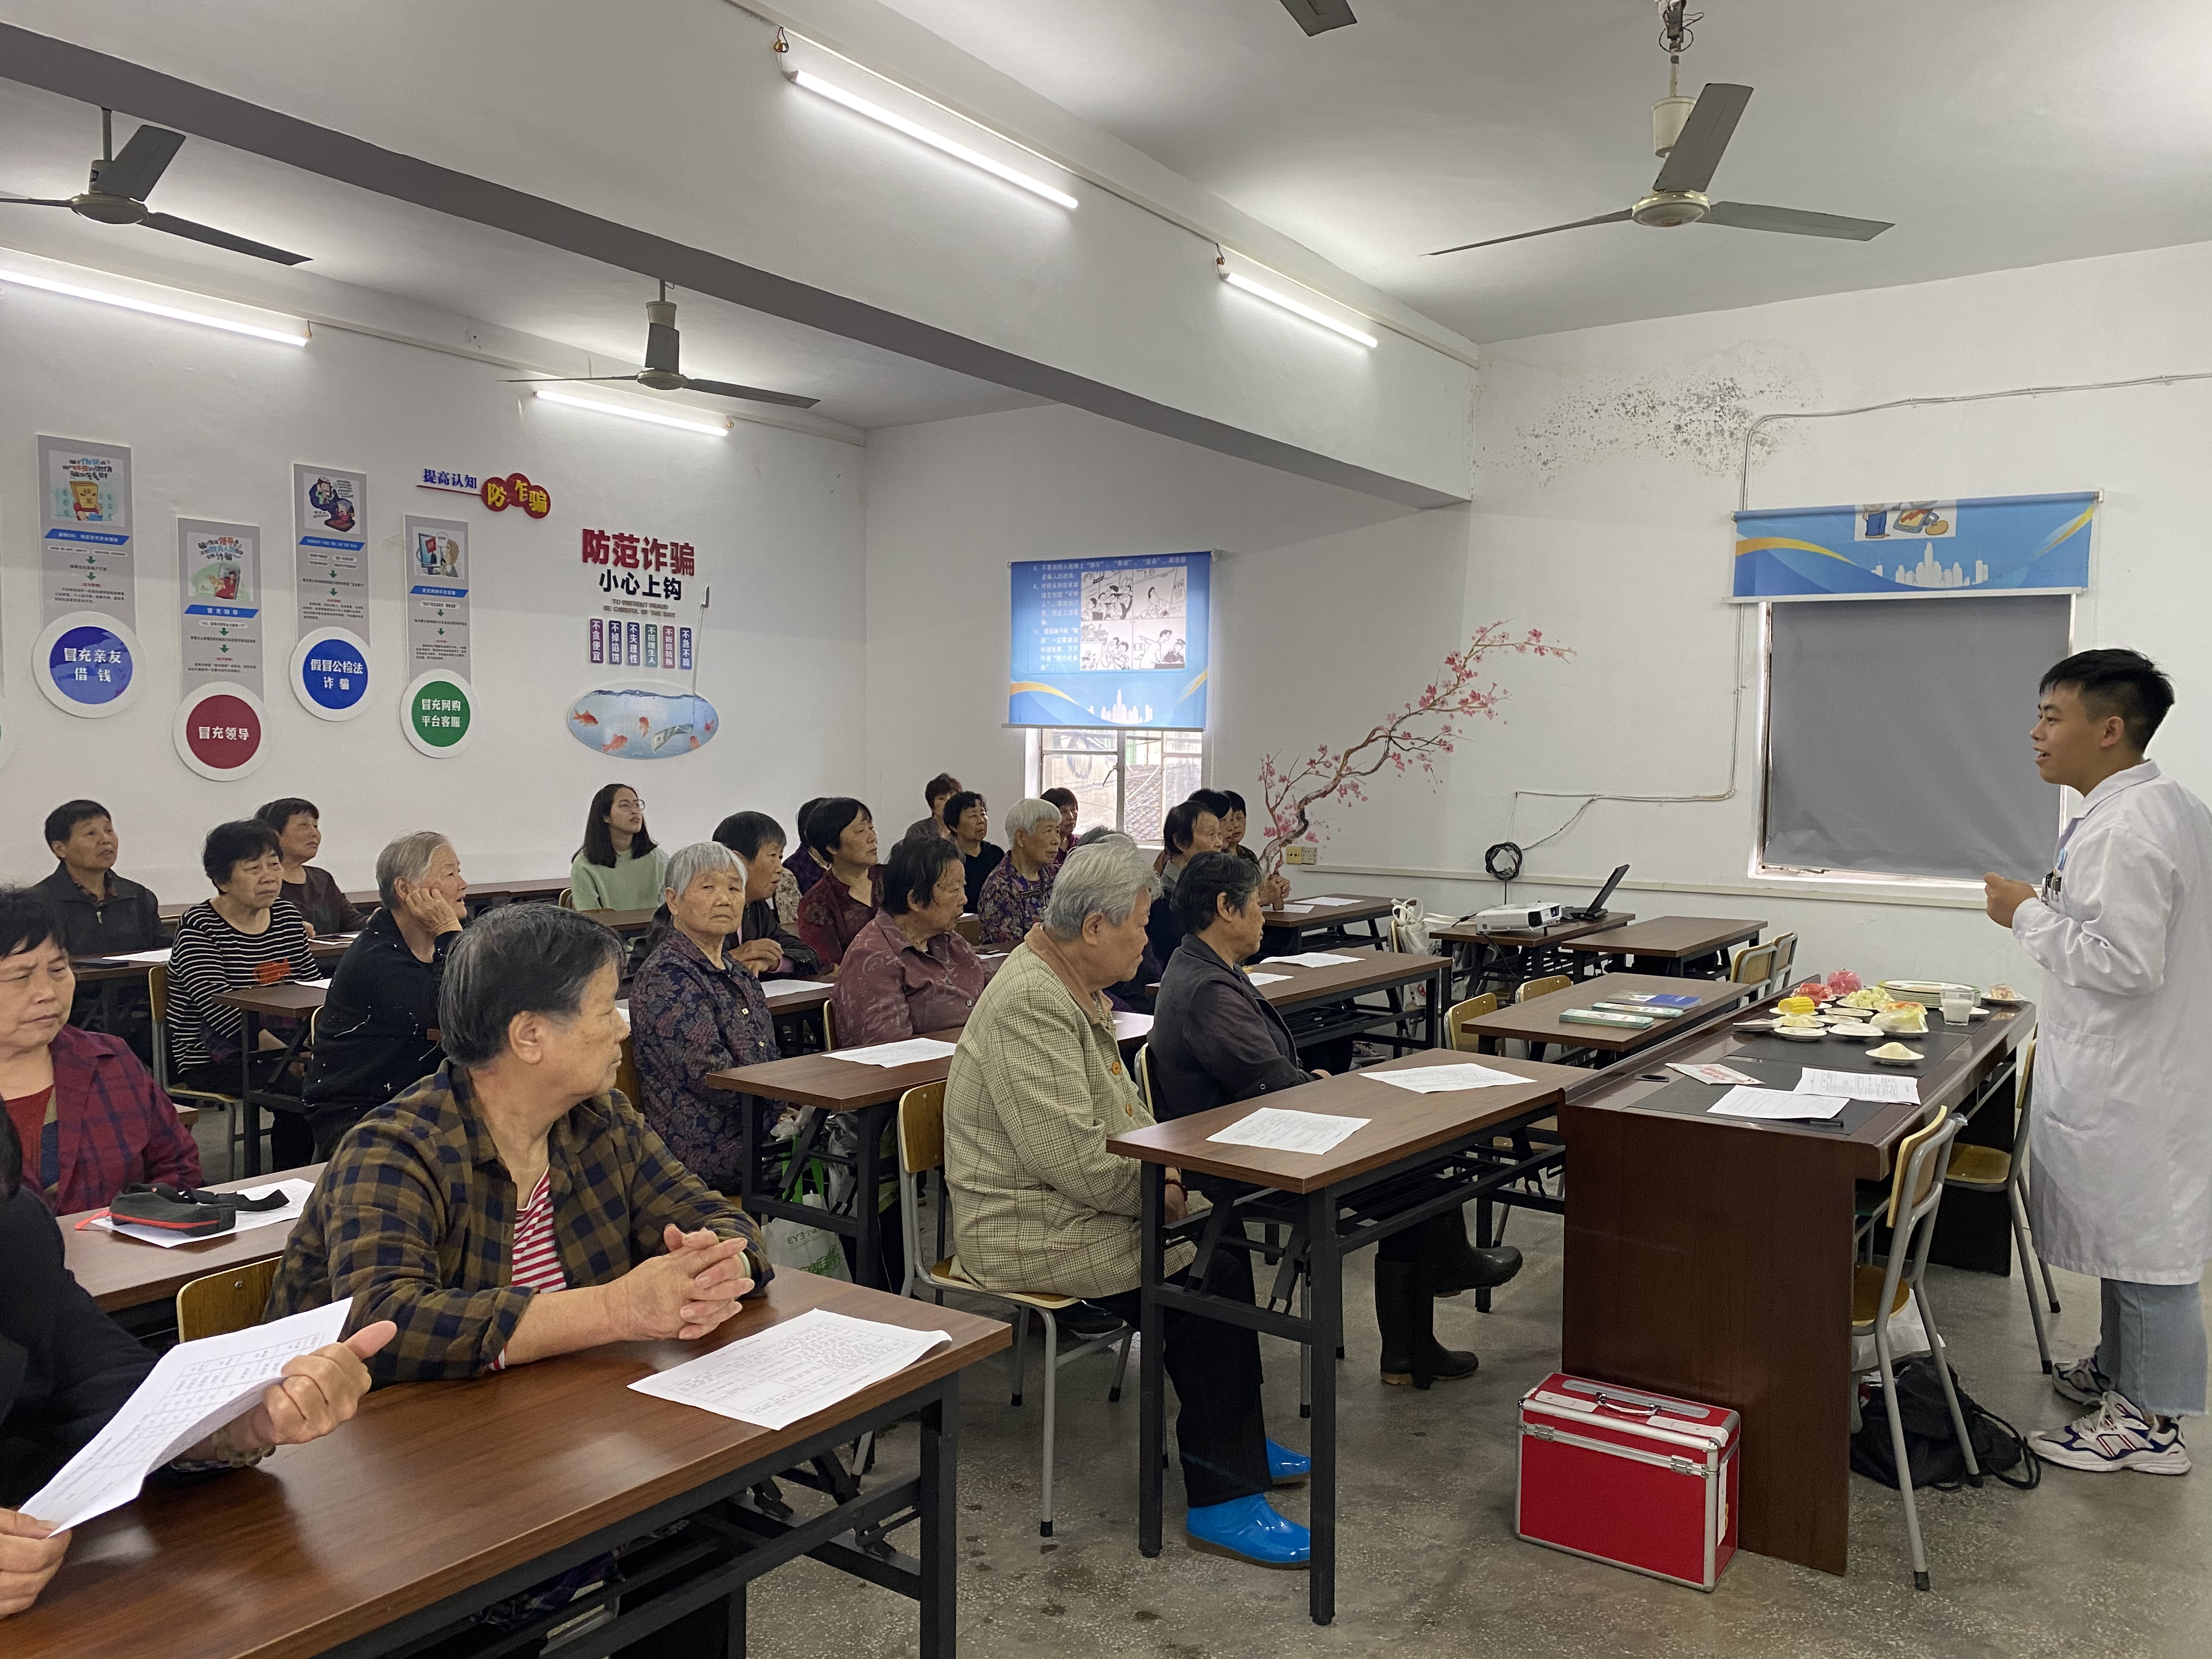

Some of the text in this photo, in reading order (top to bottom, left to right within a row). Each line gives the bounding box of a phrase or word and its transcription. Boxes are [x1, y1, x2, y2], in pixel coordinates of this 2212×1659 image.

[424, 468, 477, 488] 提高认知
[582, 528, 695, 576] 防范诈骗
[599, 569, 682, 600] 小心上钩
[592, 620, 601, 661] 不贪便宜
[629, 624, 637, 663] 不失理性
[64, 647, 121, 664] 冒充亲友
[311, 659, 363, 674] 假冒公检法
[75, 668, 111, 682] 借钱
[323, 678, 349, 690] 诈骗
[421, 699, 461, 712] 冒充网购
[421, 715, 460, 728] 平台客服
[198, 727, 249, 741] 冒充领导
